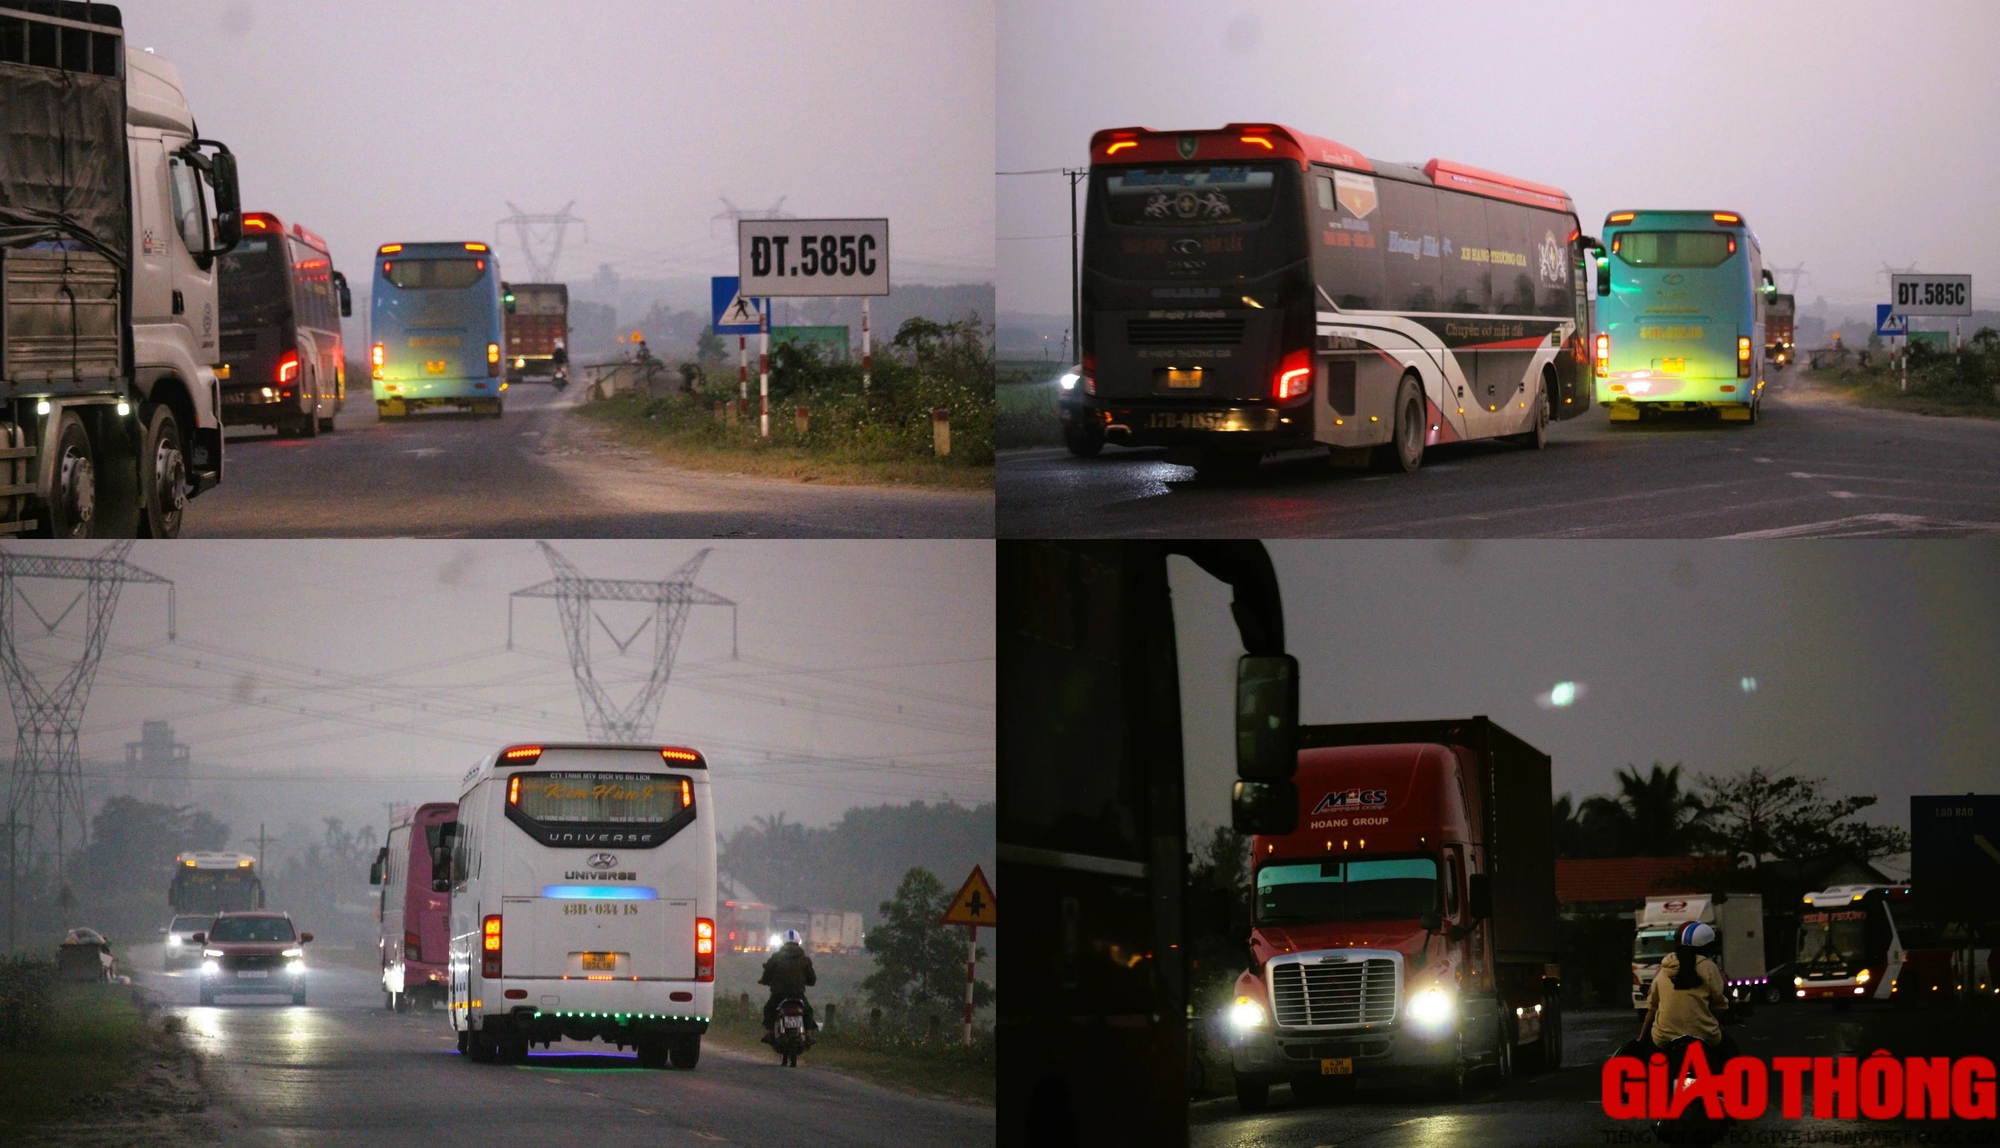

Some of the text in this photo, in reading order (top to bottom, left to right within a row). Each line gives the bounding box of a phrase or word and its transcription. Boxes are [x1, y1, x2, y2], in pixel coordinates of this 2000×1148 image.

[751, 234, 877, 277] ĐT.585C
[1898, 282, 1965, 306] ĐT.585C
[550, 772, 562, 780] CTY
[1935, 807, 1953, 818] LAO
[1311, 817, 1390, 829] HOANG GROUP
[549, 833, 652, 842] UNIVERSE
[564, 871, 637, 881] UNIVERSE
